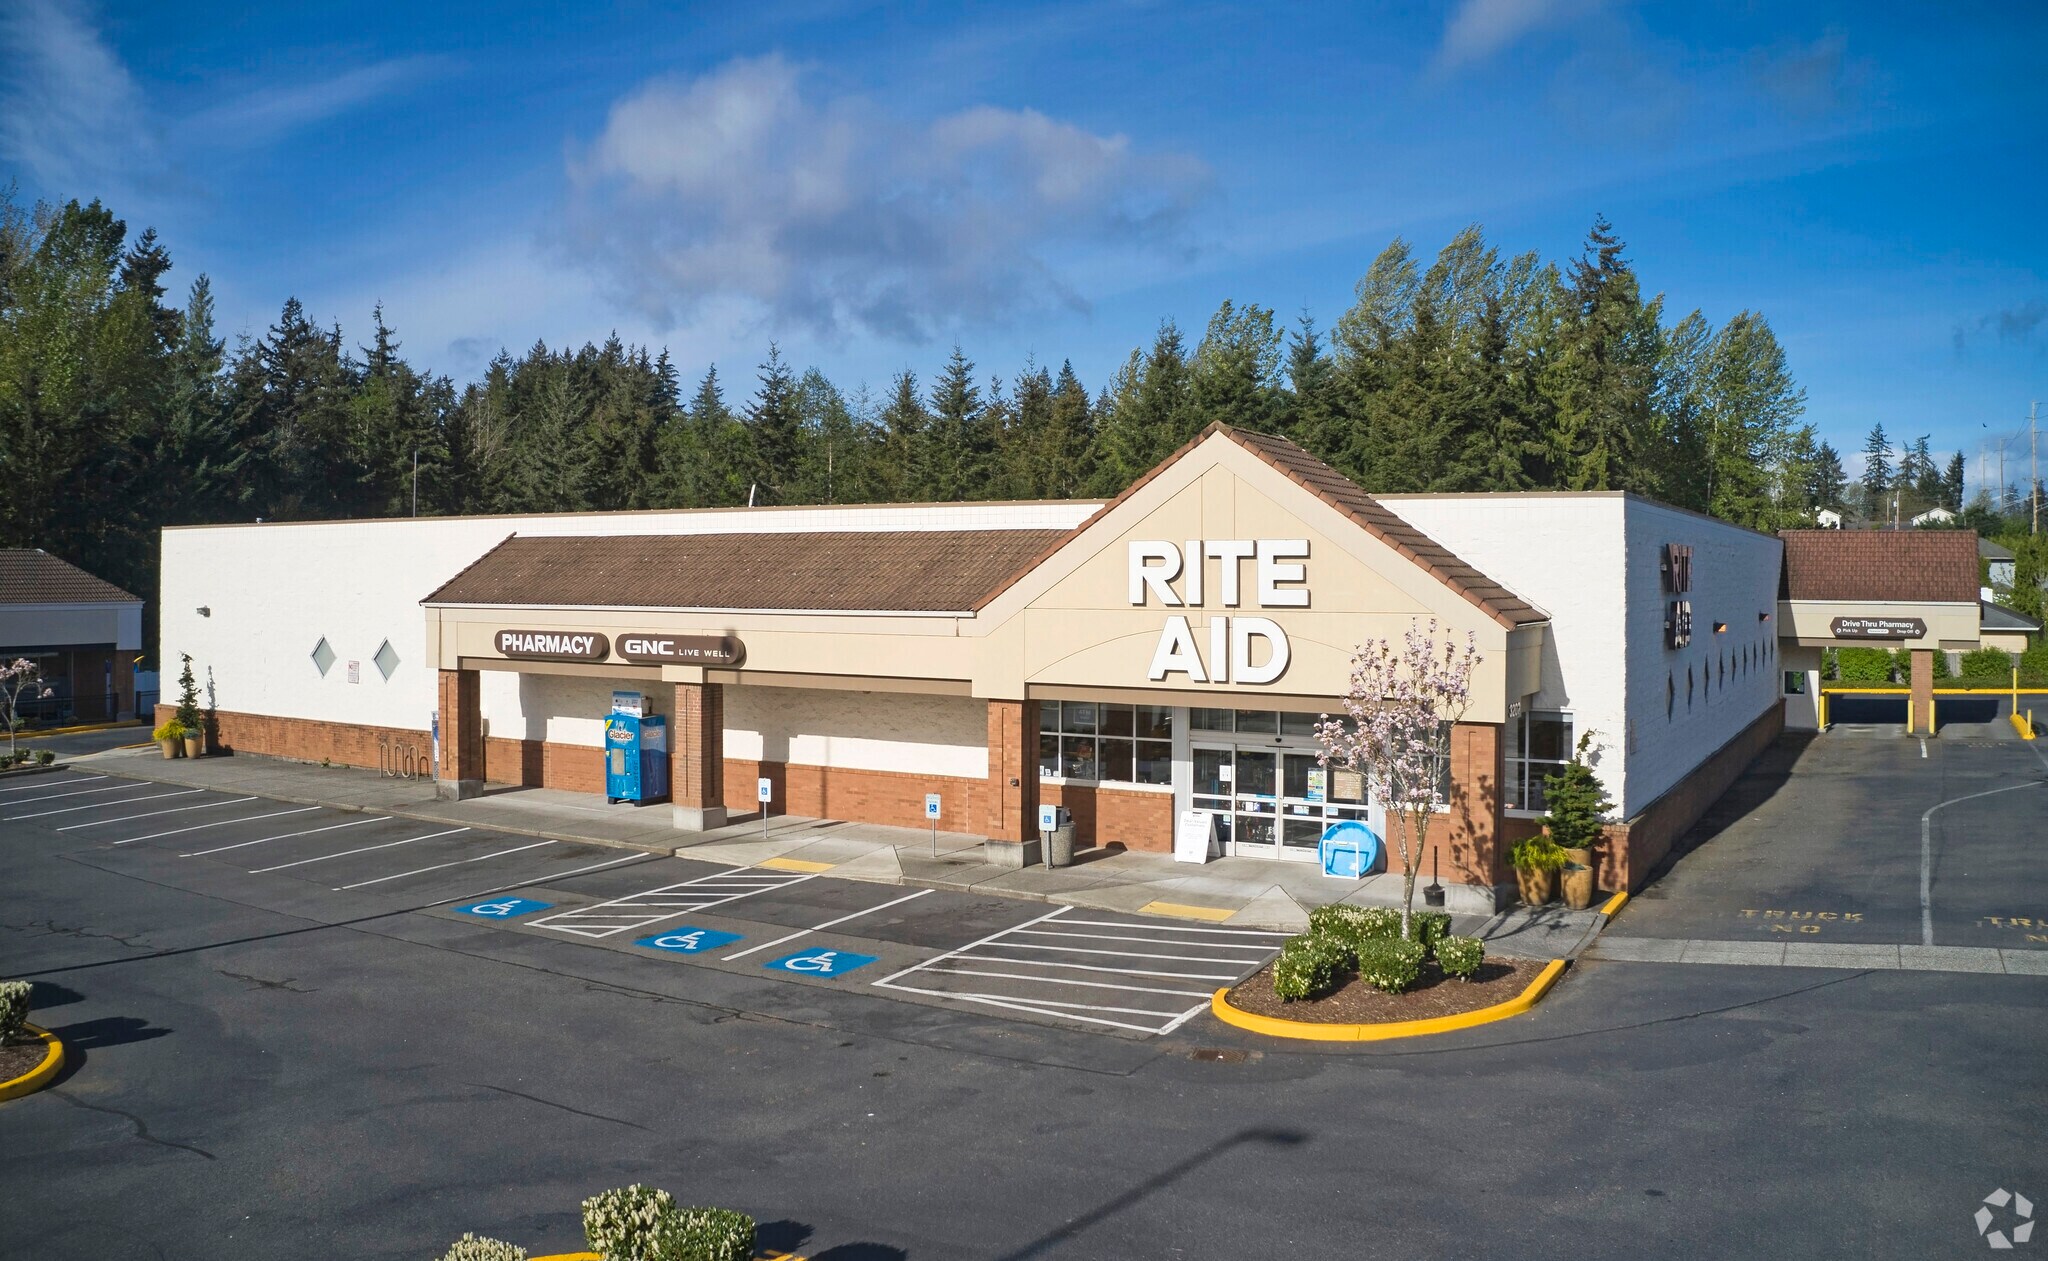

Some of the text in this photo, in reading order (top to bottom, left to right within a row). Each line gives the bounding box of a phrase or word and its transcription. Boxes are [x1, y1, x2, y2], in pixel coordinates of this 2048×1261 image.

[1128, 539, 1309, 607] RITE
[1668, 543, 1693, 592] RITE
[1879, 620, 1914, 629] Pharmacy
[501, 633, 594, 655] PHARMACY
[624, 639, 730, 658] GNC LIVE WELL
[1146, 615, 1290, 684] AID
[608, 729, 634, 740] Glacier
[1741, 909, 1863, 921] TRUCK
[1771, 924, 1821, 933] NO
